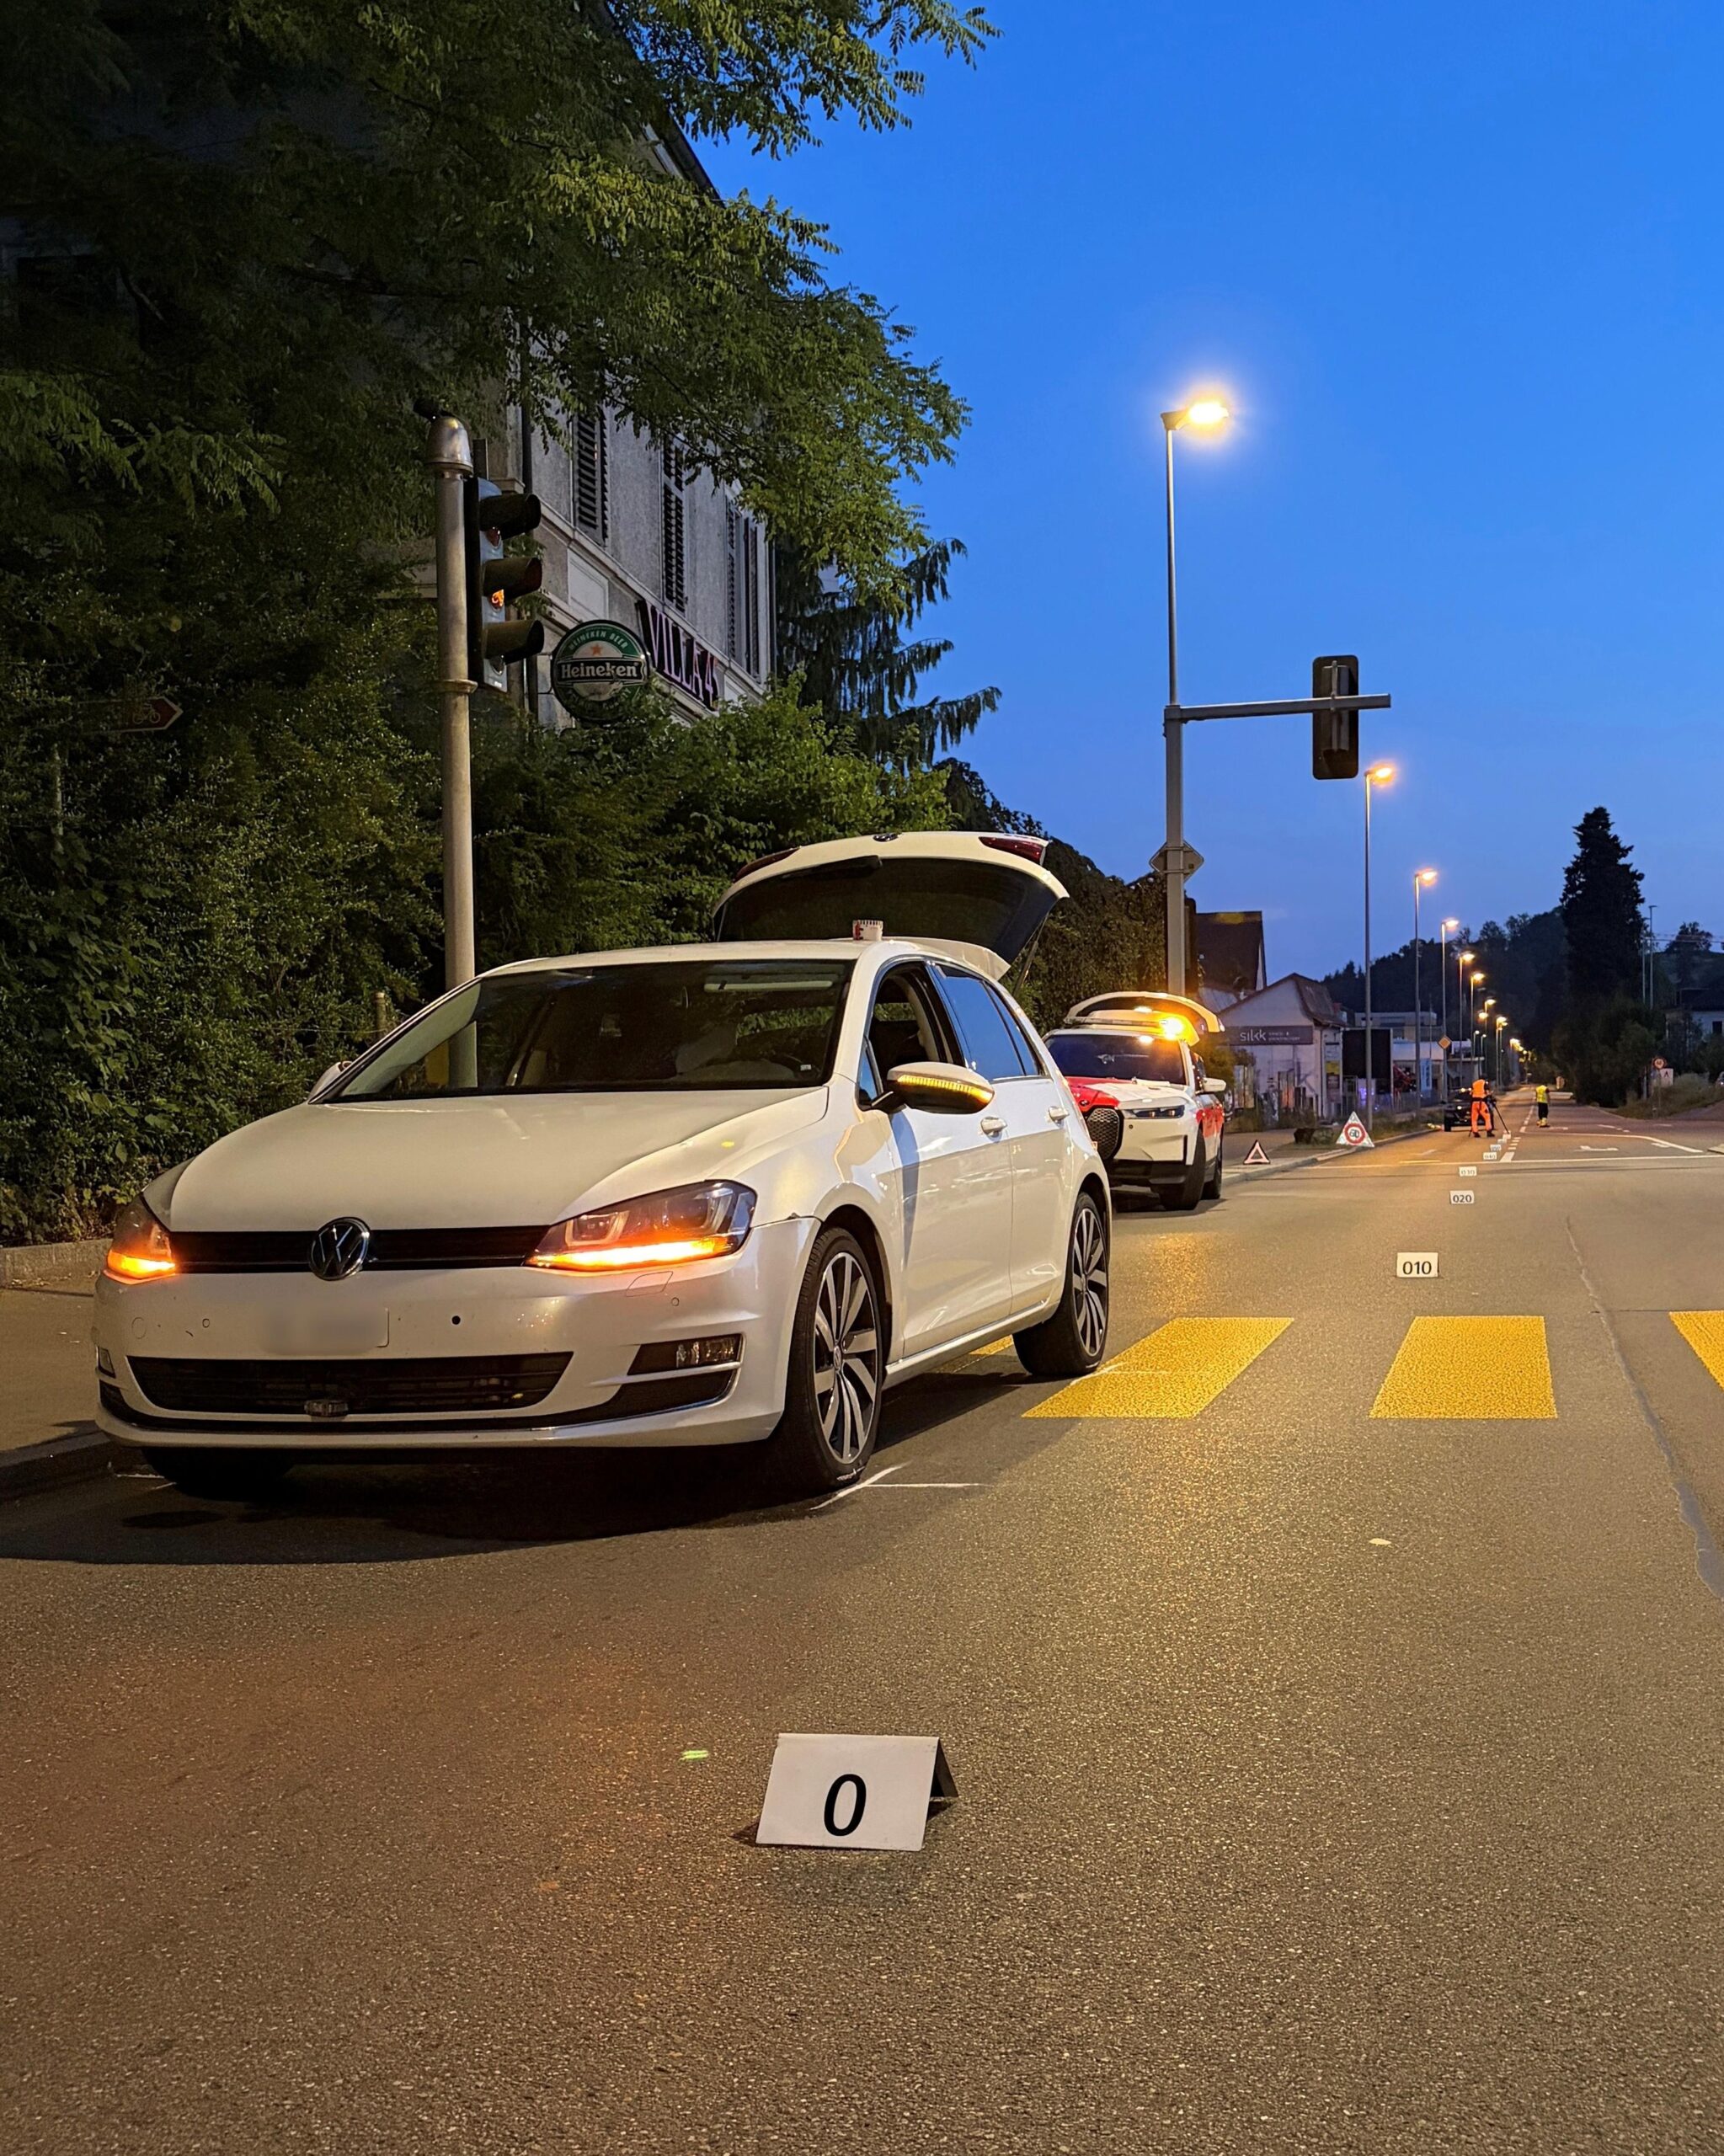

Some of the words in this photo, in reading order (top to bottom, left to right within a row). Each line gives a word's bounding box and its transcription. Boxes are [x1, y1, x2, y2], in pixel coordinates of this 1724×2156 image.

[609, 632, 629, 648] BEER
[646, 600, 704, 702] VILLA
[560, 661, 638, 679] Heineken
[1453, 1194, 1472, 1203] 020
[1402, 1260, 1432, 1275] 010
[824, 1773, 867, 1837] 0
